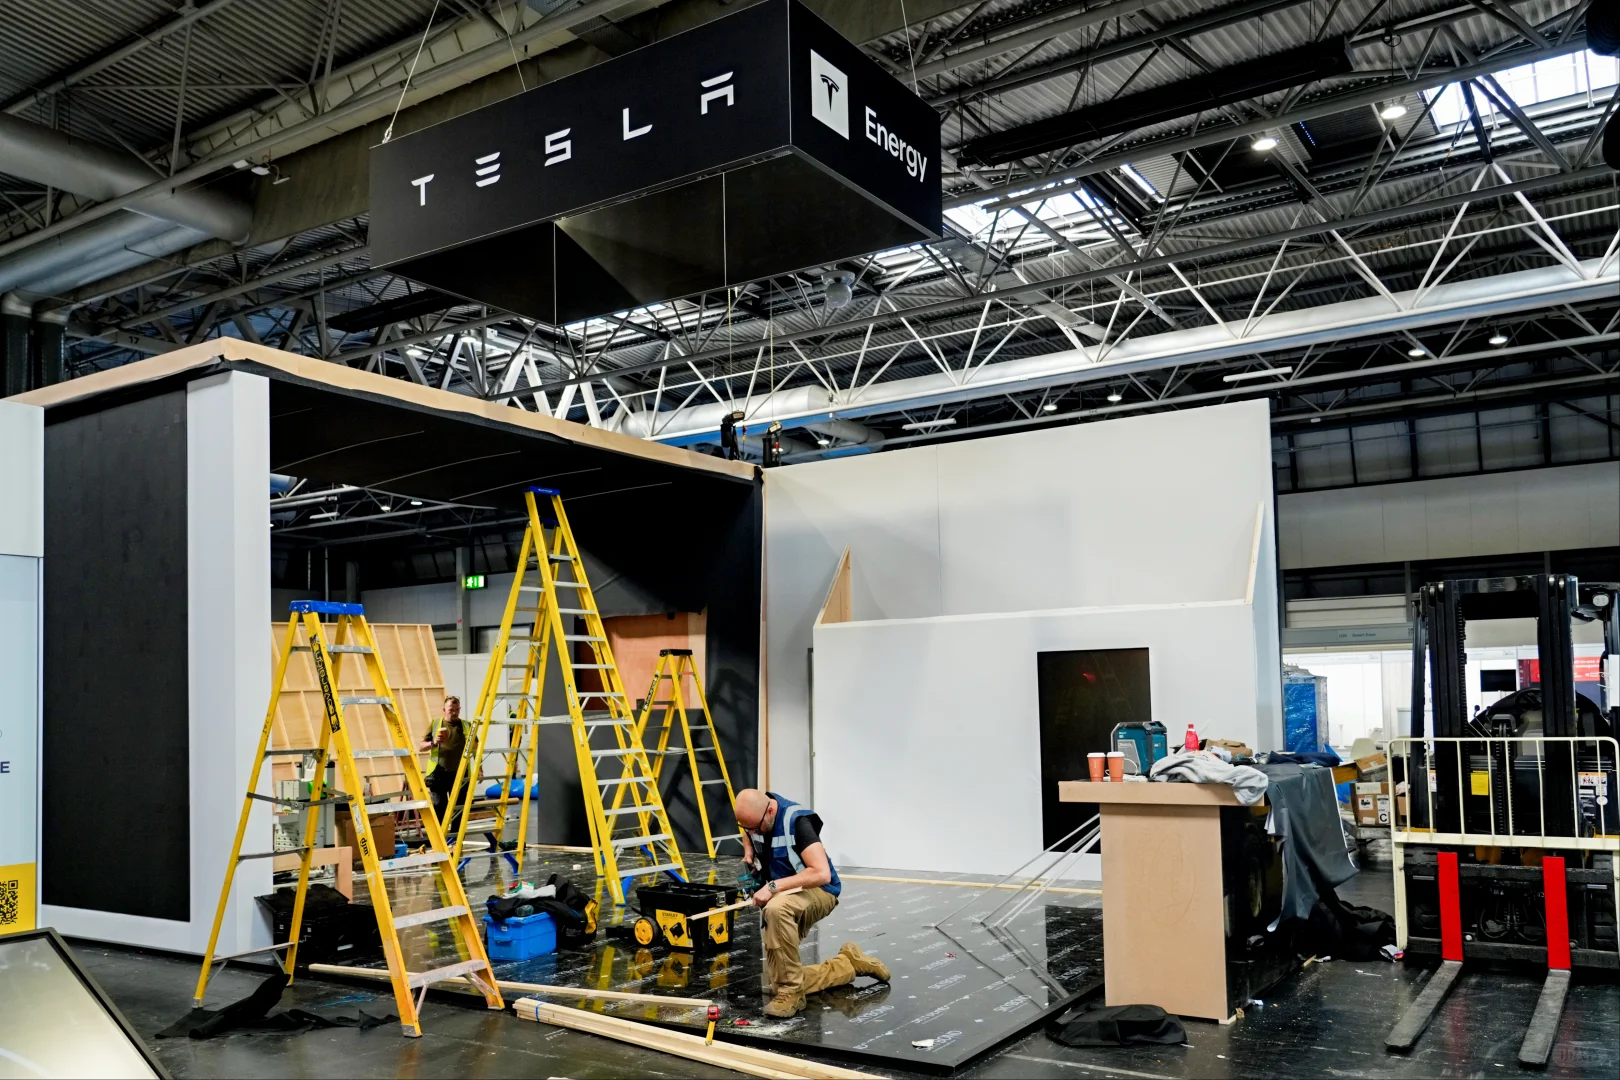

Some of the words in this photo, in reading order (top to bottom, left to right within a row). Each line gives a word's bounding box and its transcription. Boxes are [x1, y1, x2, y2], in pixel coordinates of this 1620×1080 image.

[411, 71, 735, 206] TESLA
[865, 105, 928, 183] Energy
[1379, 813, 1388, 823] C
